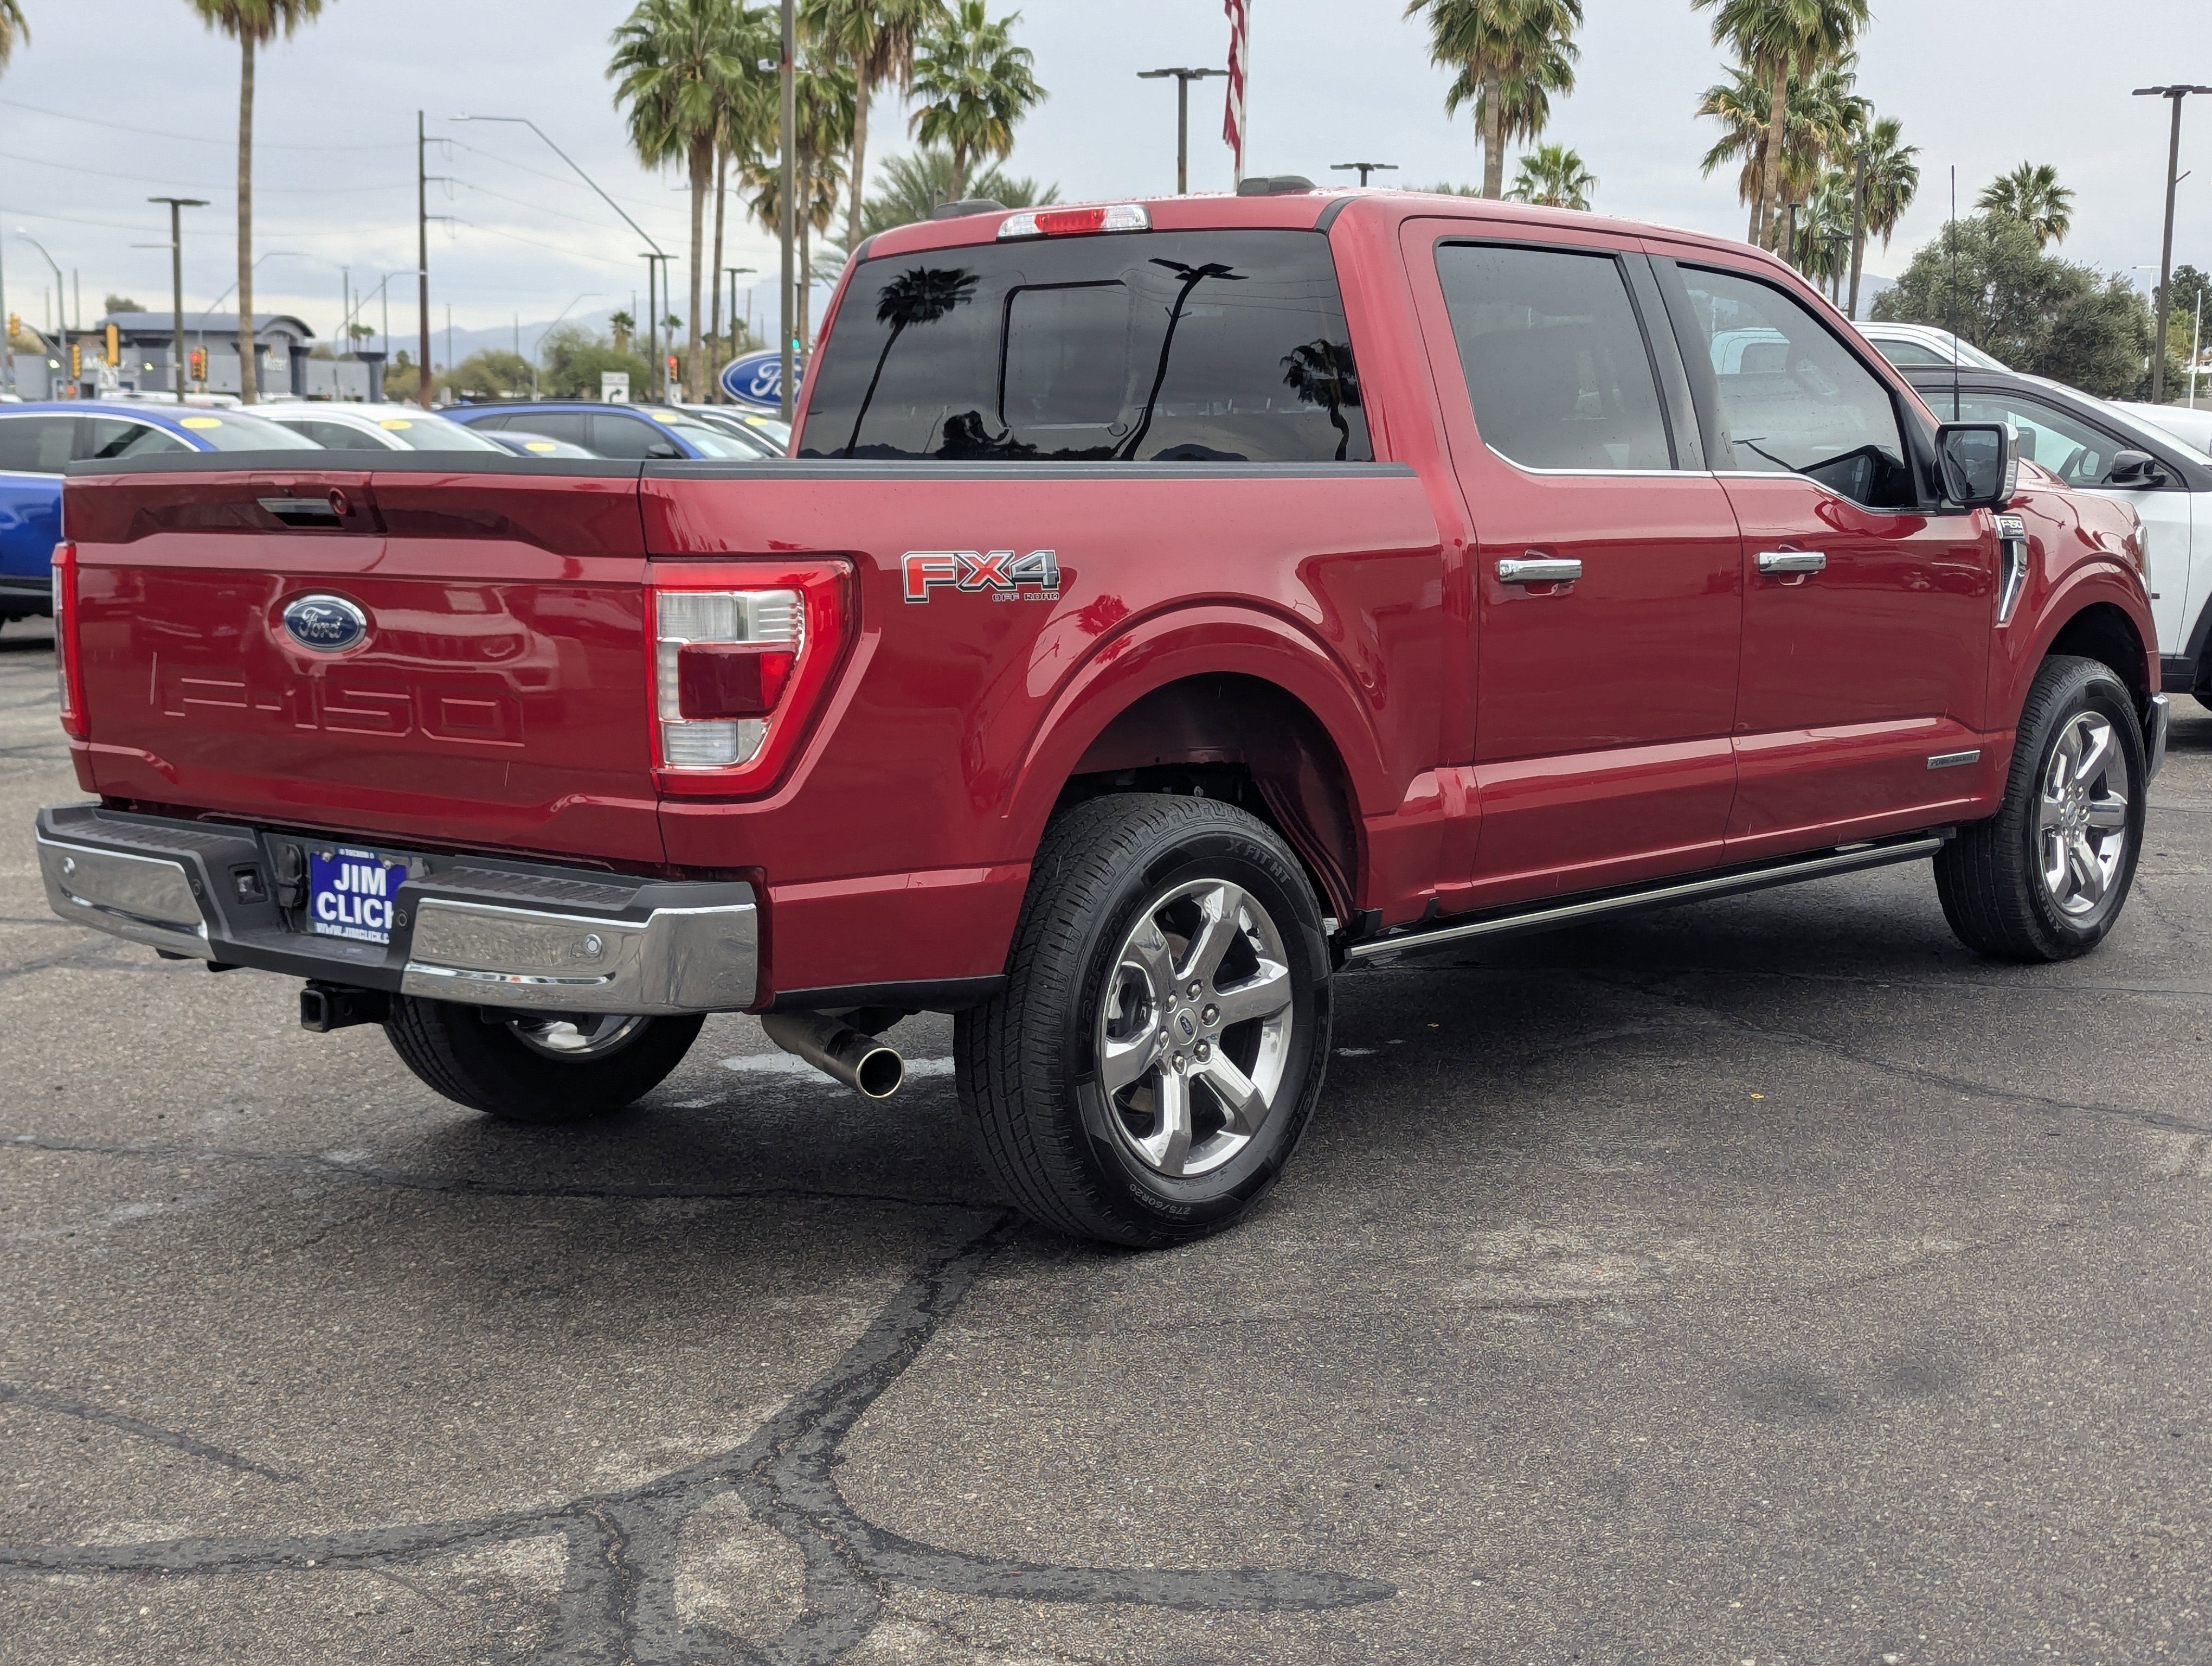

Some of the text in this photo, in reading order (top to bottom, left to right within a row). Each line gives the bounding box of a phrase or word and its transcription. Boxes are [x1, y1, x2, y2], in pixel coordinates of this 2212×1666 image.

[901, 550, 1060, 604] FX4
[992, 593, 1059, 601] OFF ROAD
[298, 606, 343, 639] Ford
[333, 863, 387, 896] JIM
